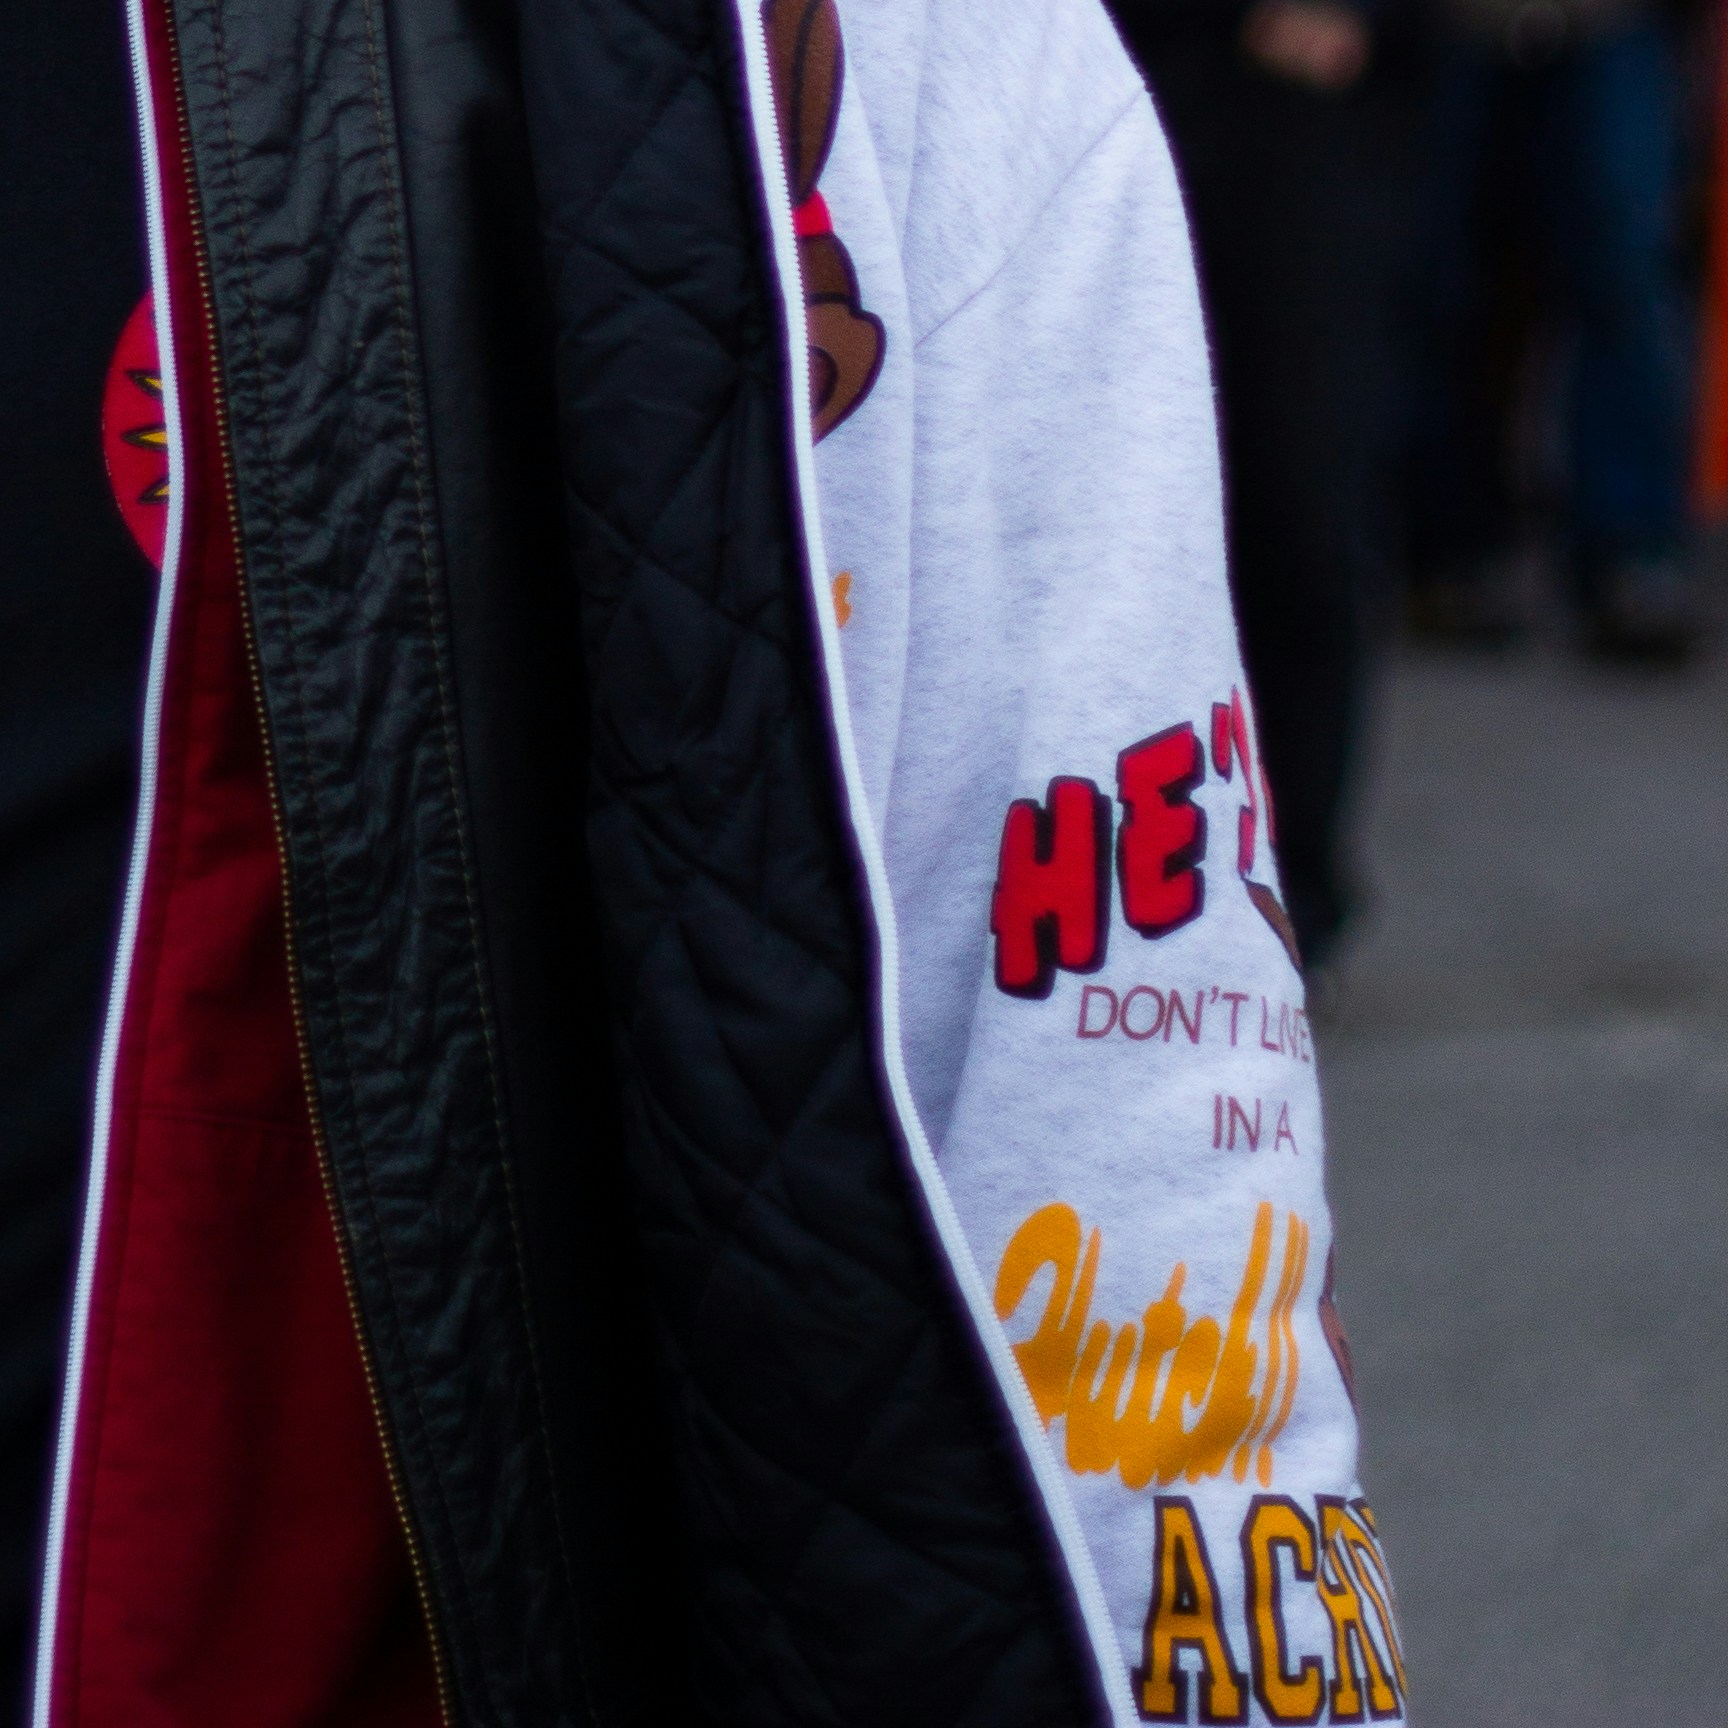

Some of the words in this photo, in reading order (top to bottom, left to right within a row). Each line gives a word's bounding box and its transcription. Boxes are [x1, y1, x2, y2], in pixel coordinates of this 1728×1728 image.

[1076, 985, 1249, 1047] DON'T
[1211, 1093, 1262, 1153] IN
[1273, 1099, 1299, 1157] A
